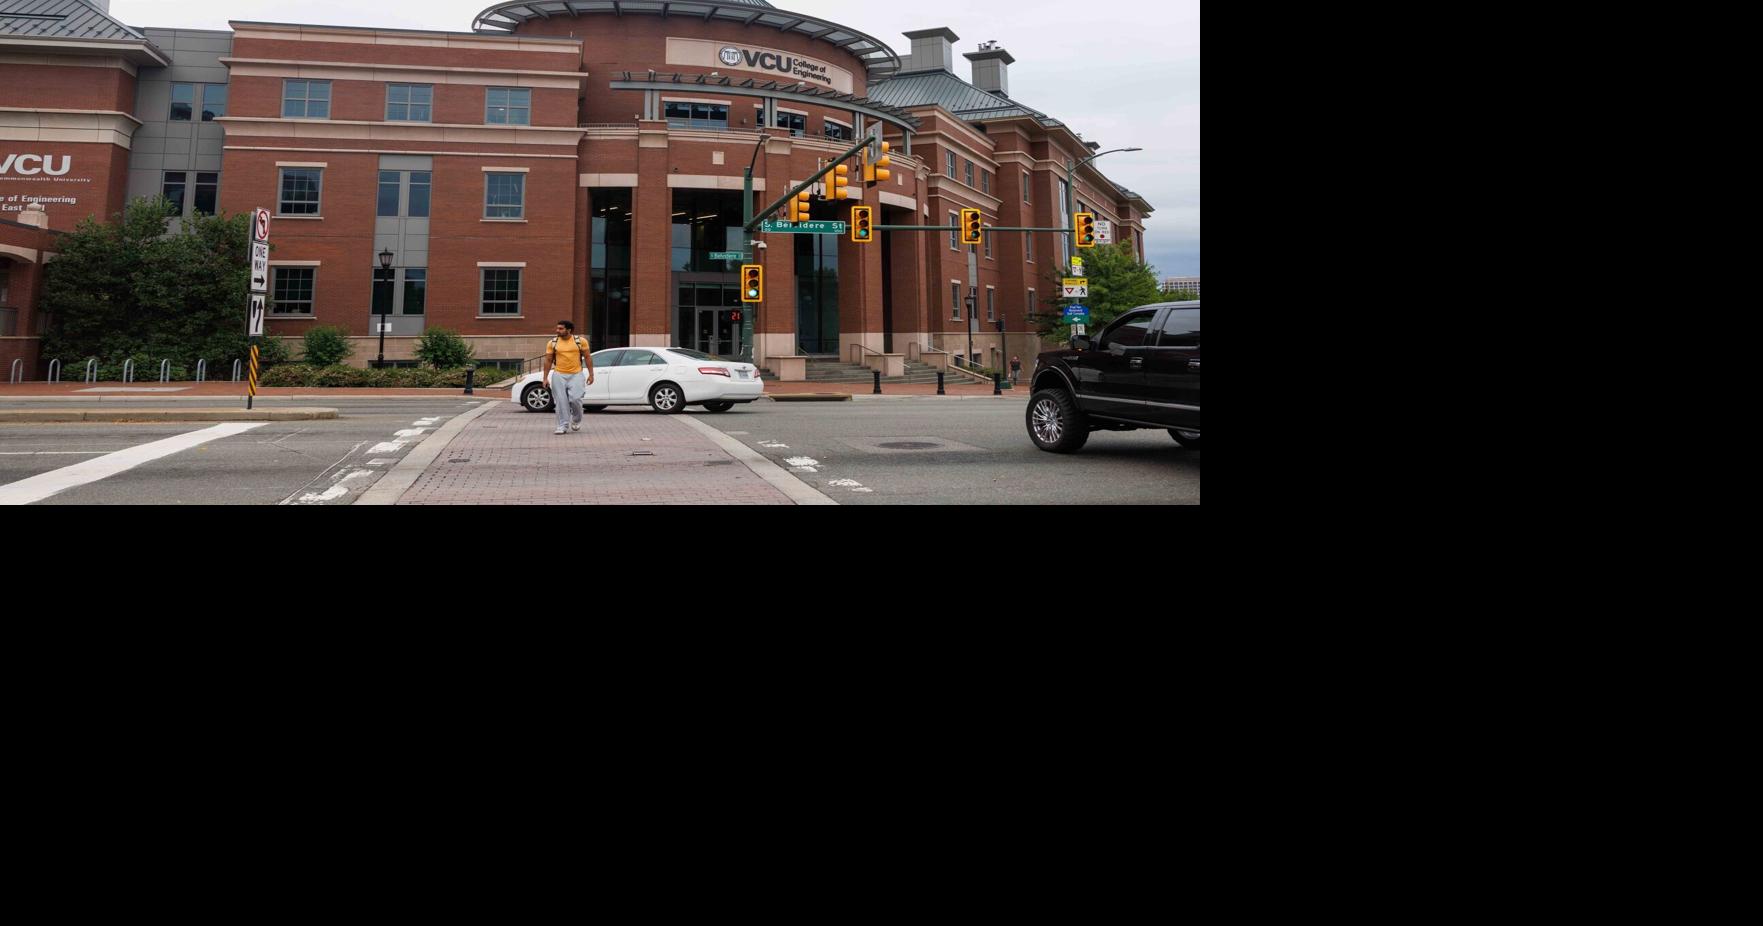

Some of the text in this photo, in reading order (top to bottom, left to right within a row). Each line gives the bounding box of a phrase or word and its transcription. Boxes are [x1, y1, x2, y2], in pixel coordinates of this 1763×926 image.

[742, 49, 792, 73] VCU
[792, 58, 826, 74] College of
[792, 67, 832, 85] Engineering
[21, 195, 77, 205] Engineering
[2, 203, 22, 211] East
[776, 221, 825, 229] Belidere
[255, 245, 267, 258] ONE
[254, 260, 266, 271] WAY
[731, 311, 741, 321] 21
